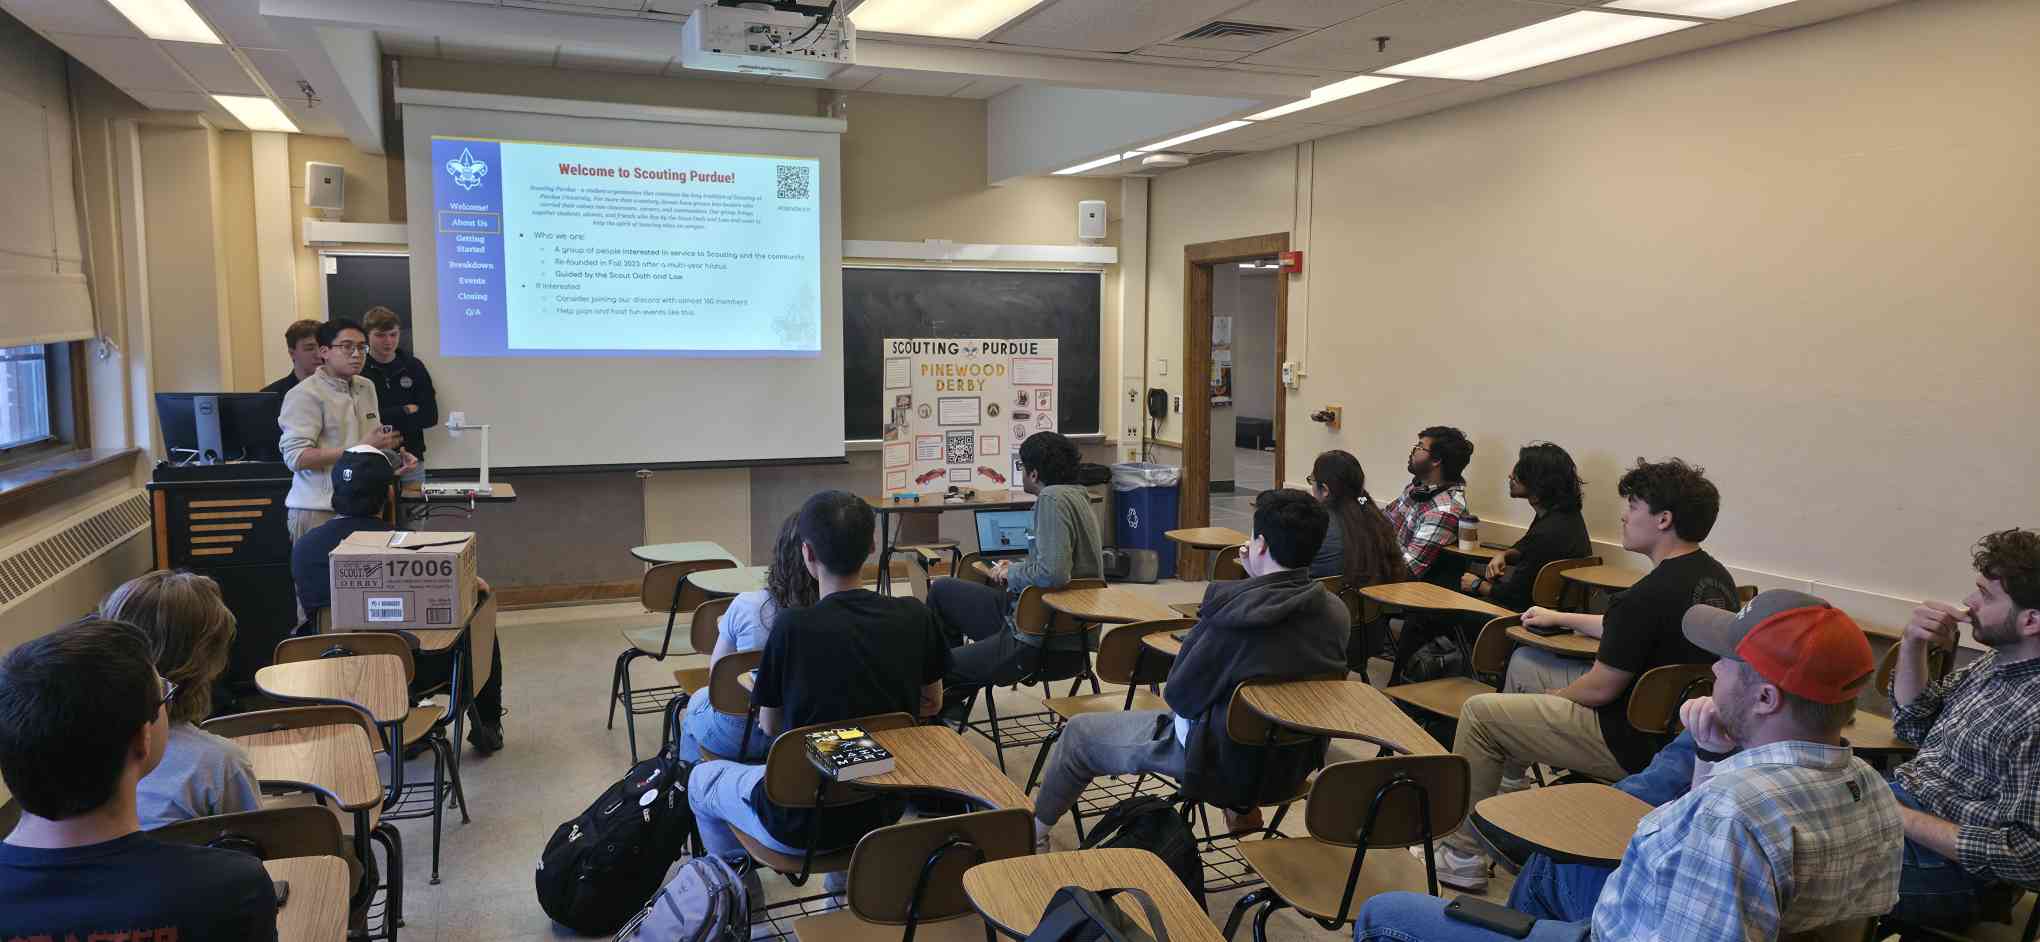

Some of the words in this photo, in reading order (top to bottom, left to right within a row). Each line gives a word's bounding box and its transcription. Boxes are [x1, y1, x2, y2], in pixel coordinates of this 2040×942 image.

[559, 163, 614, 177] Welcome
[619, 166, 630, 178] to
[634, 167, 687, 184] Scouting
[690, 170, 735, 184] Purdue!
[450, 201, 489, 211] Welcome!
[451, 218, 476, 228] About
[477, 219, 488, 228] Us
[456, 234, 486, 244] Getting
[534, 232, 553, 240] Who
[456, 245, 486, 254] Started
[622, 248, 660, 256] interested
[706, 250, 738, 259] Scouting
[448, 260, 495, 270] Breakdown
[555, 270, 583, 278] Guided
[584, 271, 593, 280] by
[608, 271, 630, 279] Scout
[632, 272, 651, 280] Oath
[652, 272, 667, 280] and
[458, 276, 486, 285] Events
[457, 292, 488, 302] Closing
[892, 341, 959, 355] SCOUTING
[982, 342, 1039, 355] PURDUE
[920, 363, 1005, 377] PINEWOOD
[936, 379, 985, 392] DERBY
[386, 560, 452, 577] 17006
[837, 752, 887, 765] MARY
